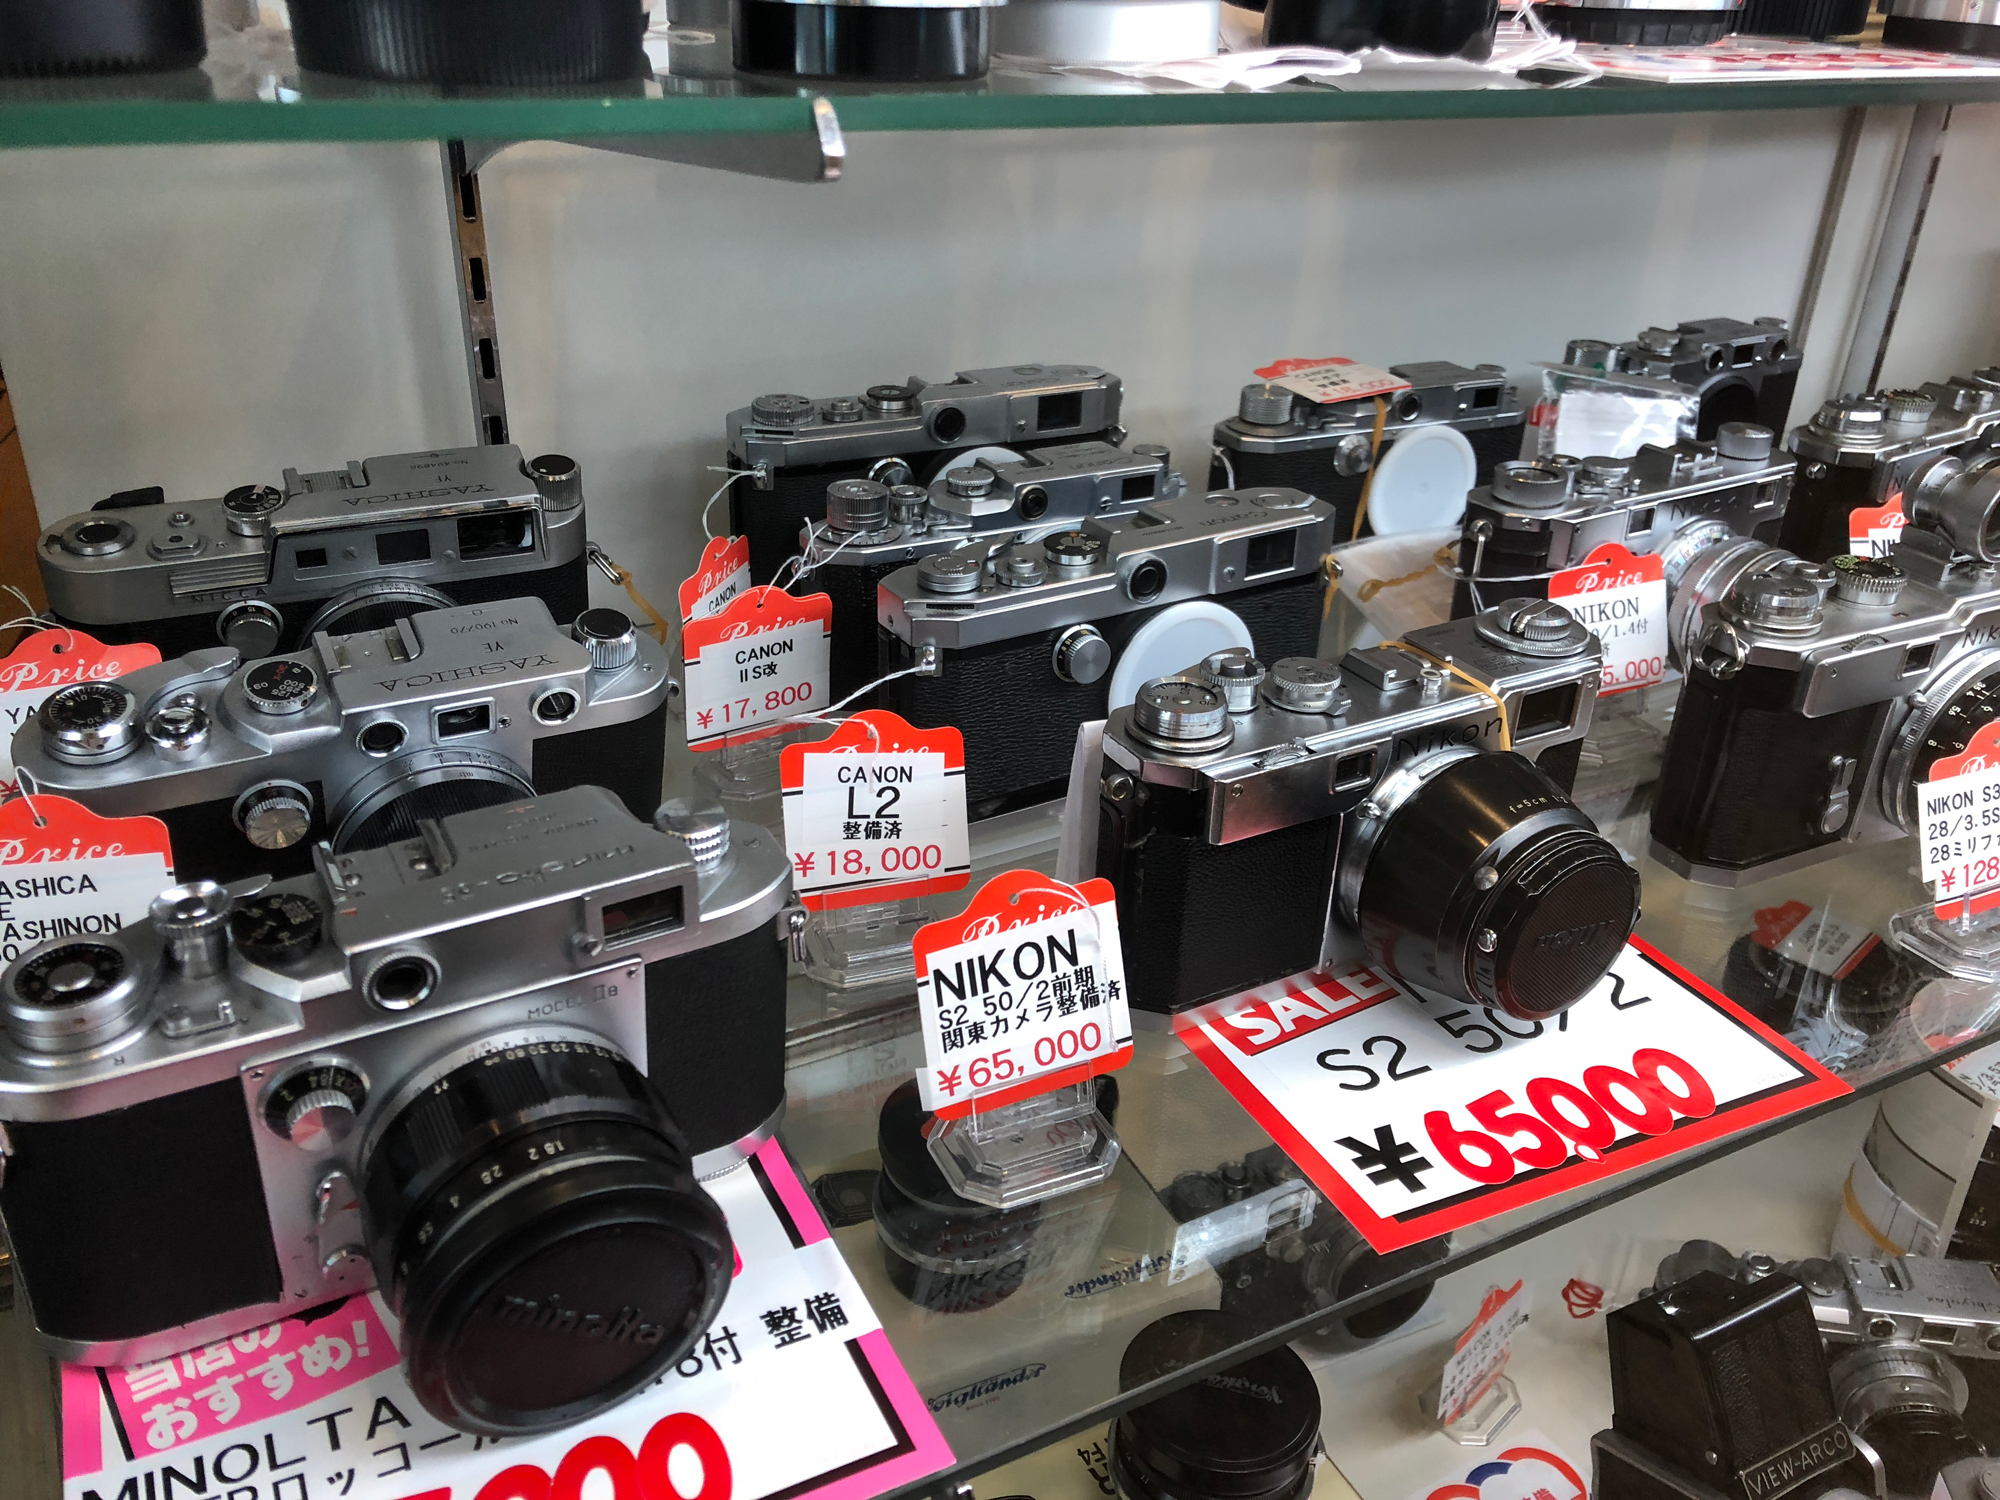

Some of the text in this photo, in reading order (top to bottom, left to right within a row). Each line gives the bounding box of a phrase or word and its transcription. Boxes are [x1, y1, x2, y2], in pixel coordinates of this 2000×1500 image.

[344, 484, 495, 507] YASHICA
[1198, 510, 1268, 528] Canon
[708, 581, 737, 613] CANON
[1576, 569, 1643, 595] Price
[1573, 597, 1640, 625] NIKON
[1591, 618, 1649, 642] 0/1.4付
[1961, 625, 2000, 649] Nik
[734, 638, 794, 665] CANON
[0, 658, 122, 693] Price
[373, 654, 560, 692] YASHICA
[1602, 656, 1663, 686] 5,000
[5, 705, 38, 725] YA
[695, 681, 813, 729] ¥17,800
[1396, 716, 1504, 762] Nikon
[836, 765, 914, 785] CANON
[846, 786, 901, 820] L2
[1926, 789, 1975, 817] NIKON
[842, 821, 903, 841] 整備済
[1928, 807, 2000, 841] 28/3.5S
[794, 844, 942, 878] ¥18,000
[1941, 855, 2000, 893] ¥128
[0, 873, 98, 901] ASHICA
[0, 904, 15, 921] E
[3, 912, 123, 943] ASHINON
[932, 928, 1080, 1008] NIKON
[938, 1004, 970, 1031] S2
[941, 980, 1122, 1054] 関東カメラ整備済
[1229, 965, 1392, 1046] SALE
[936, 1022, 1103, 1097] ¥65,000
[1315, 1035, 1433, 1092] S2
[1333, 1046, 1716, 1194] ¥65,000
[527, 1147, 540, 1161] 2
[760, 1291, 851, 1350] 整備
[1747, 1430, 1848, 1495] VIEW-ARCO
